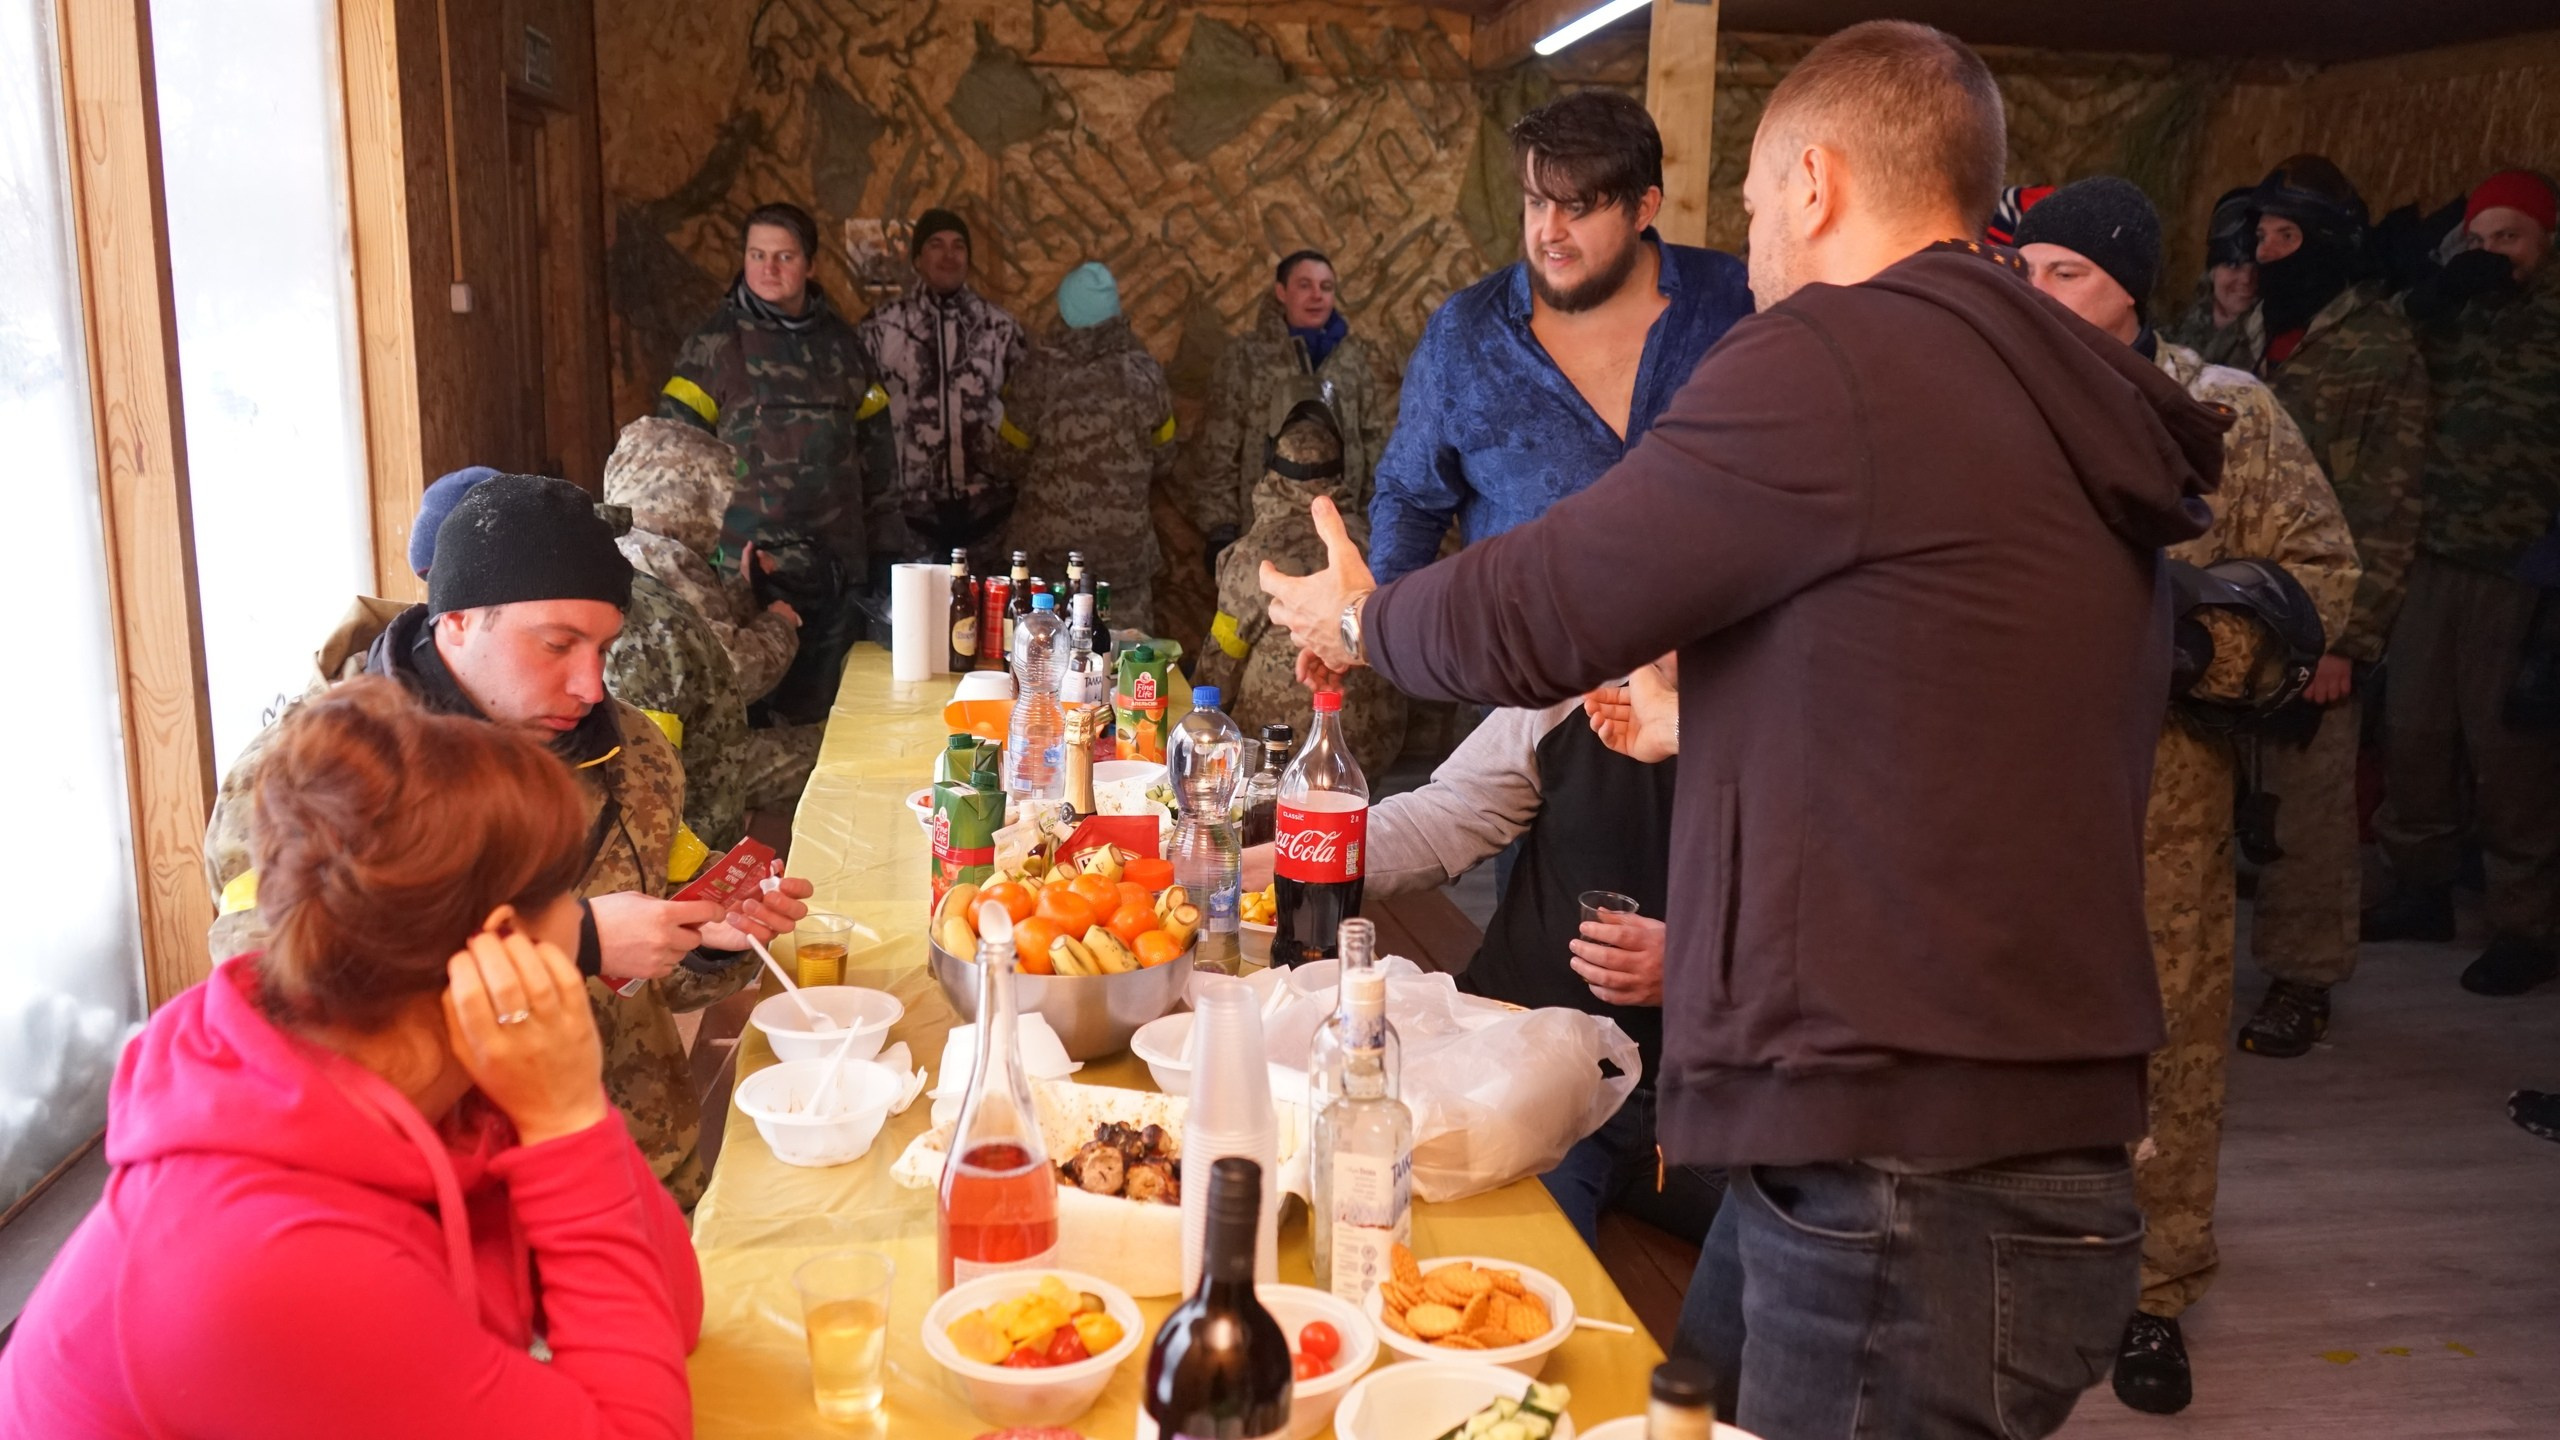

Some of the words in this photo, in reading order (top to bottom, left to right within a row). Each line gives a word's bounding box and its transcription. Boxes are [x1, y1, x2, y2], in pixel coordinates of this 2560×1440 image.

[1137, 684, 1154, 692] Fine
[1137, 690, 1153, 699] Life
[1283, 811, 1304, 821] CLASSIC
[1350, 815, 1355, 823] 2
[936, 821, 949, 834] Fine
[936, 829, 948, 845] Life
